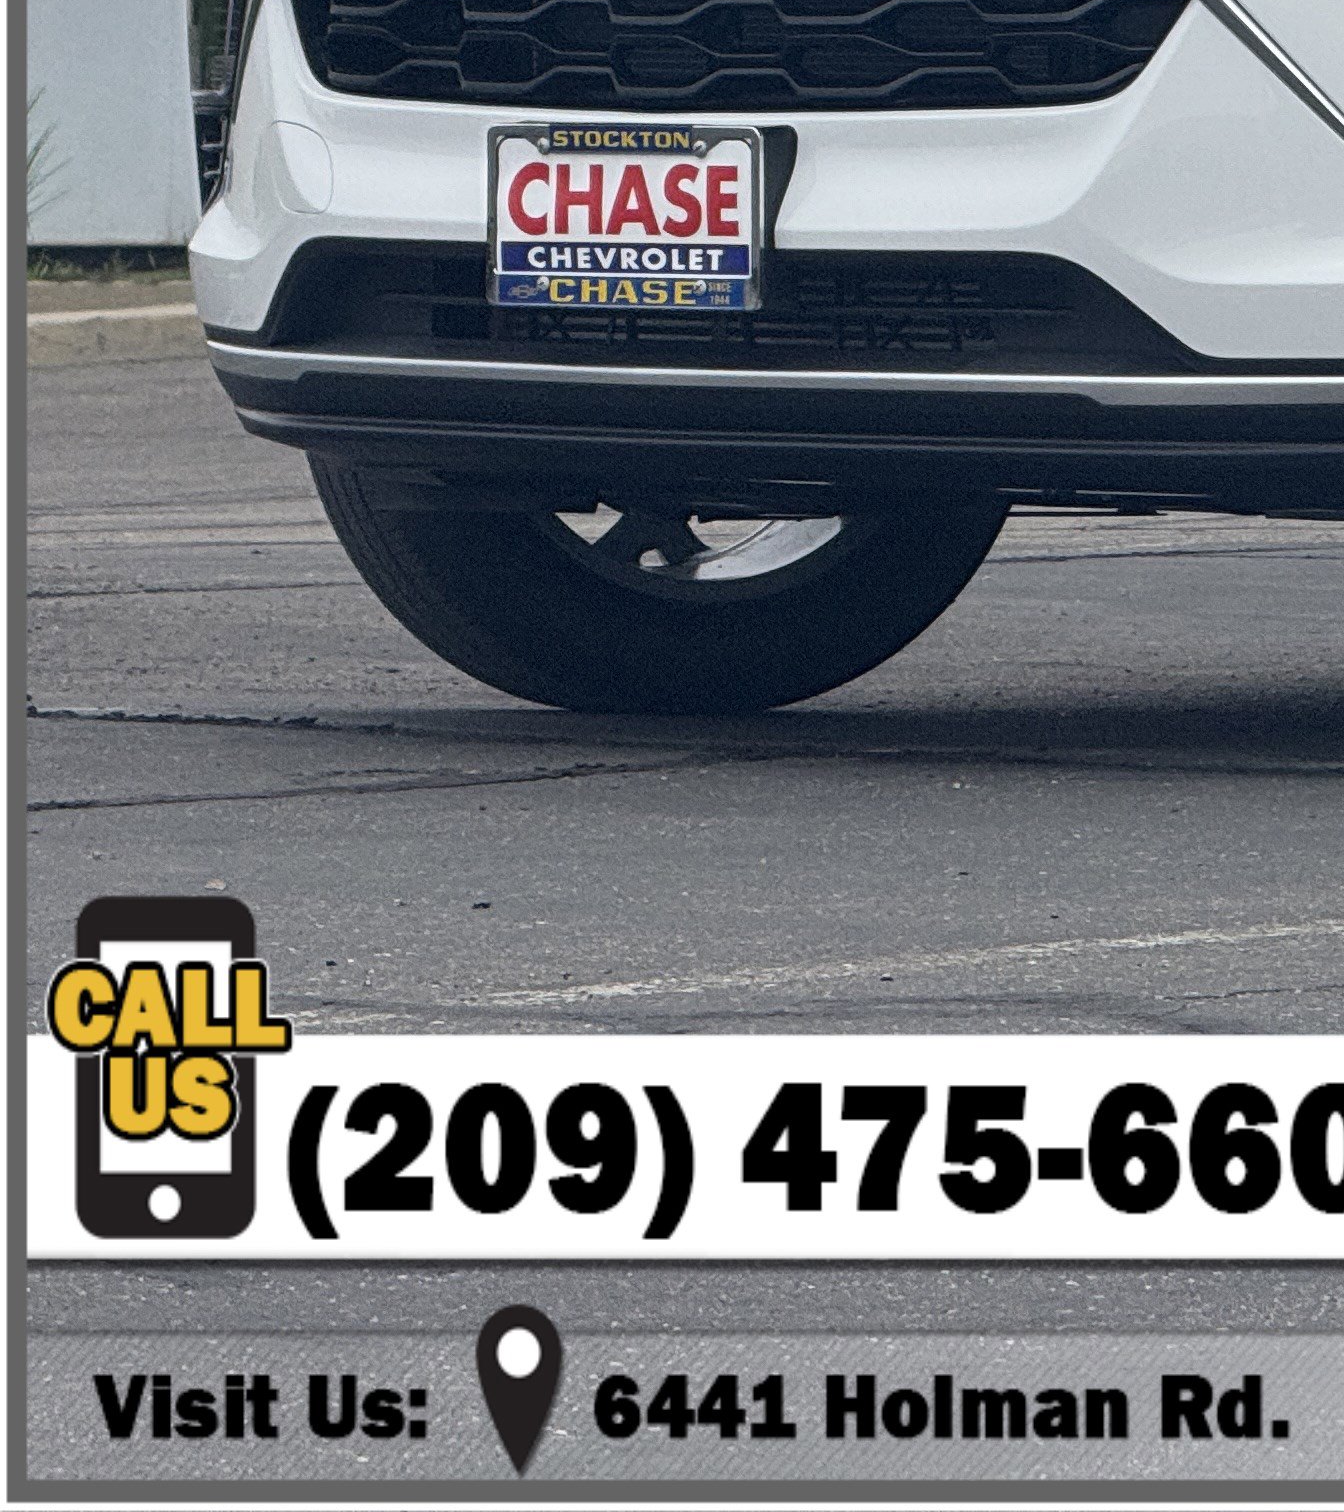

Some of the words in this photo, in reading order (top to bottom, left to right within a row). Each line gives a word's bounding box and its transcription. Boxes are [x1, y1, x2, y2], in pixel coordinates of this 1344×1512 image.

[552, 130, 690, 149] STOCKTON
[507, 162, 740, 238] CHASE
[527, 246, 724, 271] CHEVROLET
[550, 278, 698, 305] CHASE
